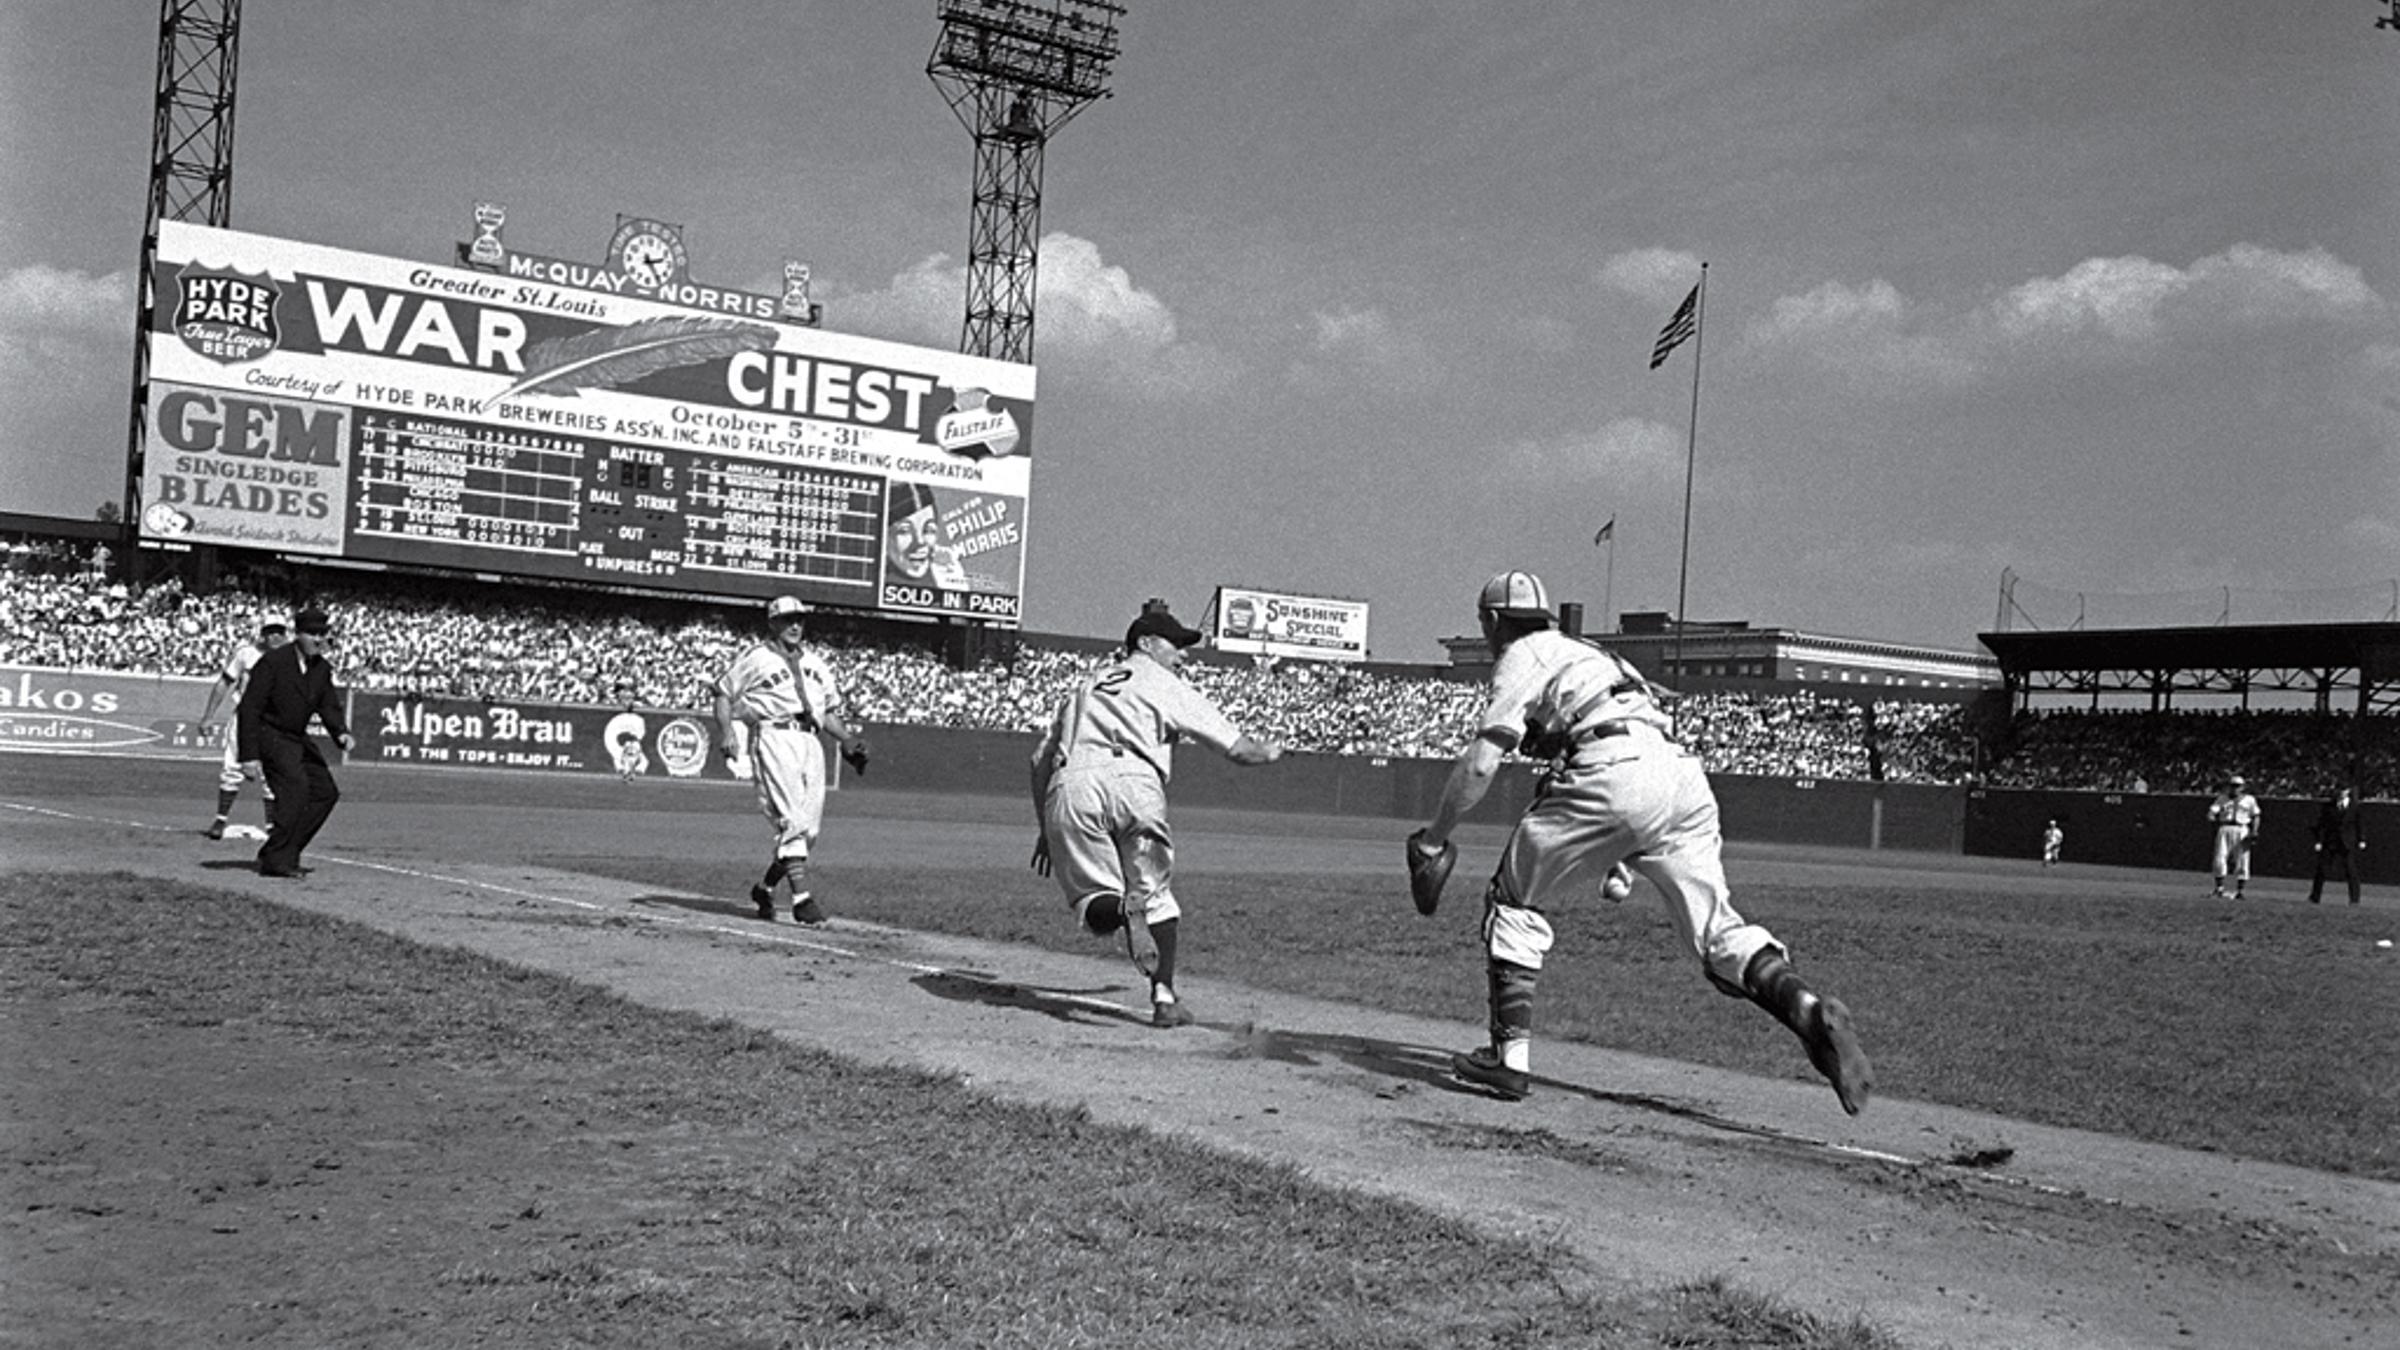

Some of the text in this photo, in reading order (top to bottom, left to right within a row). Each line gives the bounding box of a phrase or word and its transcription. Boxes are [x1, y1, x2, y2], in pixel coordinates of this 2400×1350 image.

[188, 279, 269, 311] HYDE
[409, 268, 504, 299] Greater
[510, 254, 628, 292] McQUAY
[659, 284, 775, 318] NORRIS
[187, 300, 268, 333] PARK
[306, 280, 528, 373] WAR
[203, 340, 248, 359] BEER
[245, 368, 344, 400] Courtesy of
[727, 351, 933, 430] CHEST
[158, 391, 344, 468] GEM
[356, 383, 414, 405] HYDE
[424, 392, 484, 414] PARK
[499, 403, 607, 431] BREWERIES
[706, 432, 742, 451] AND
[747, 437, 827, 460] FALSTAFF
[830, 447, 892, 470] BREWING
[896, 456, 984, 481] CORPORATION
[672, 406, 777, 436] October
[944, 416, 1004, 440] FALSTAFF
[610, 446, 664, 466] BATTER
[176, 456, 319, 488] SINGLEDGE
[159, 474, 330, 520] BLADES
[590, 488, 678, 512] BALL STRIKE
[619, 525, 645, 541] OUT
[946, 500, 1007, 540] PHILIP
[953, 522, 1019, 558] MORRIS
[885, 585, 1018, 614] SOLD IN PARK
[1266, 600, 1349, 623] SUNSHINE
[1286, 619, 1344, 638] SPECIAL
[1093, 669, 1133, 696] 2
[0, 718, 94, 739] Candies
[380, 700, 573, 745] Alpen Brau
[383, 744, 411, 758] IT'S
[419, 747, 449, 761] THE
